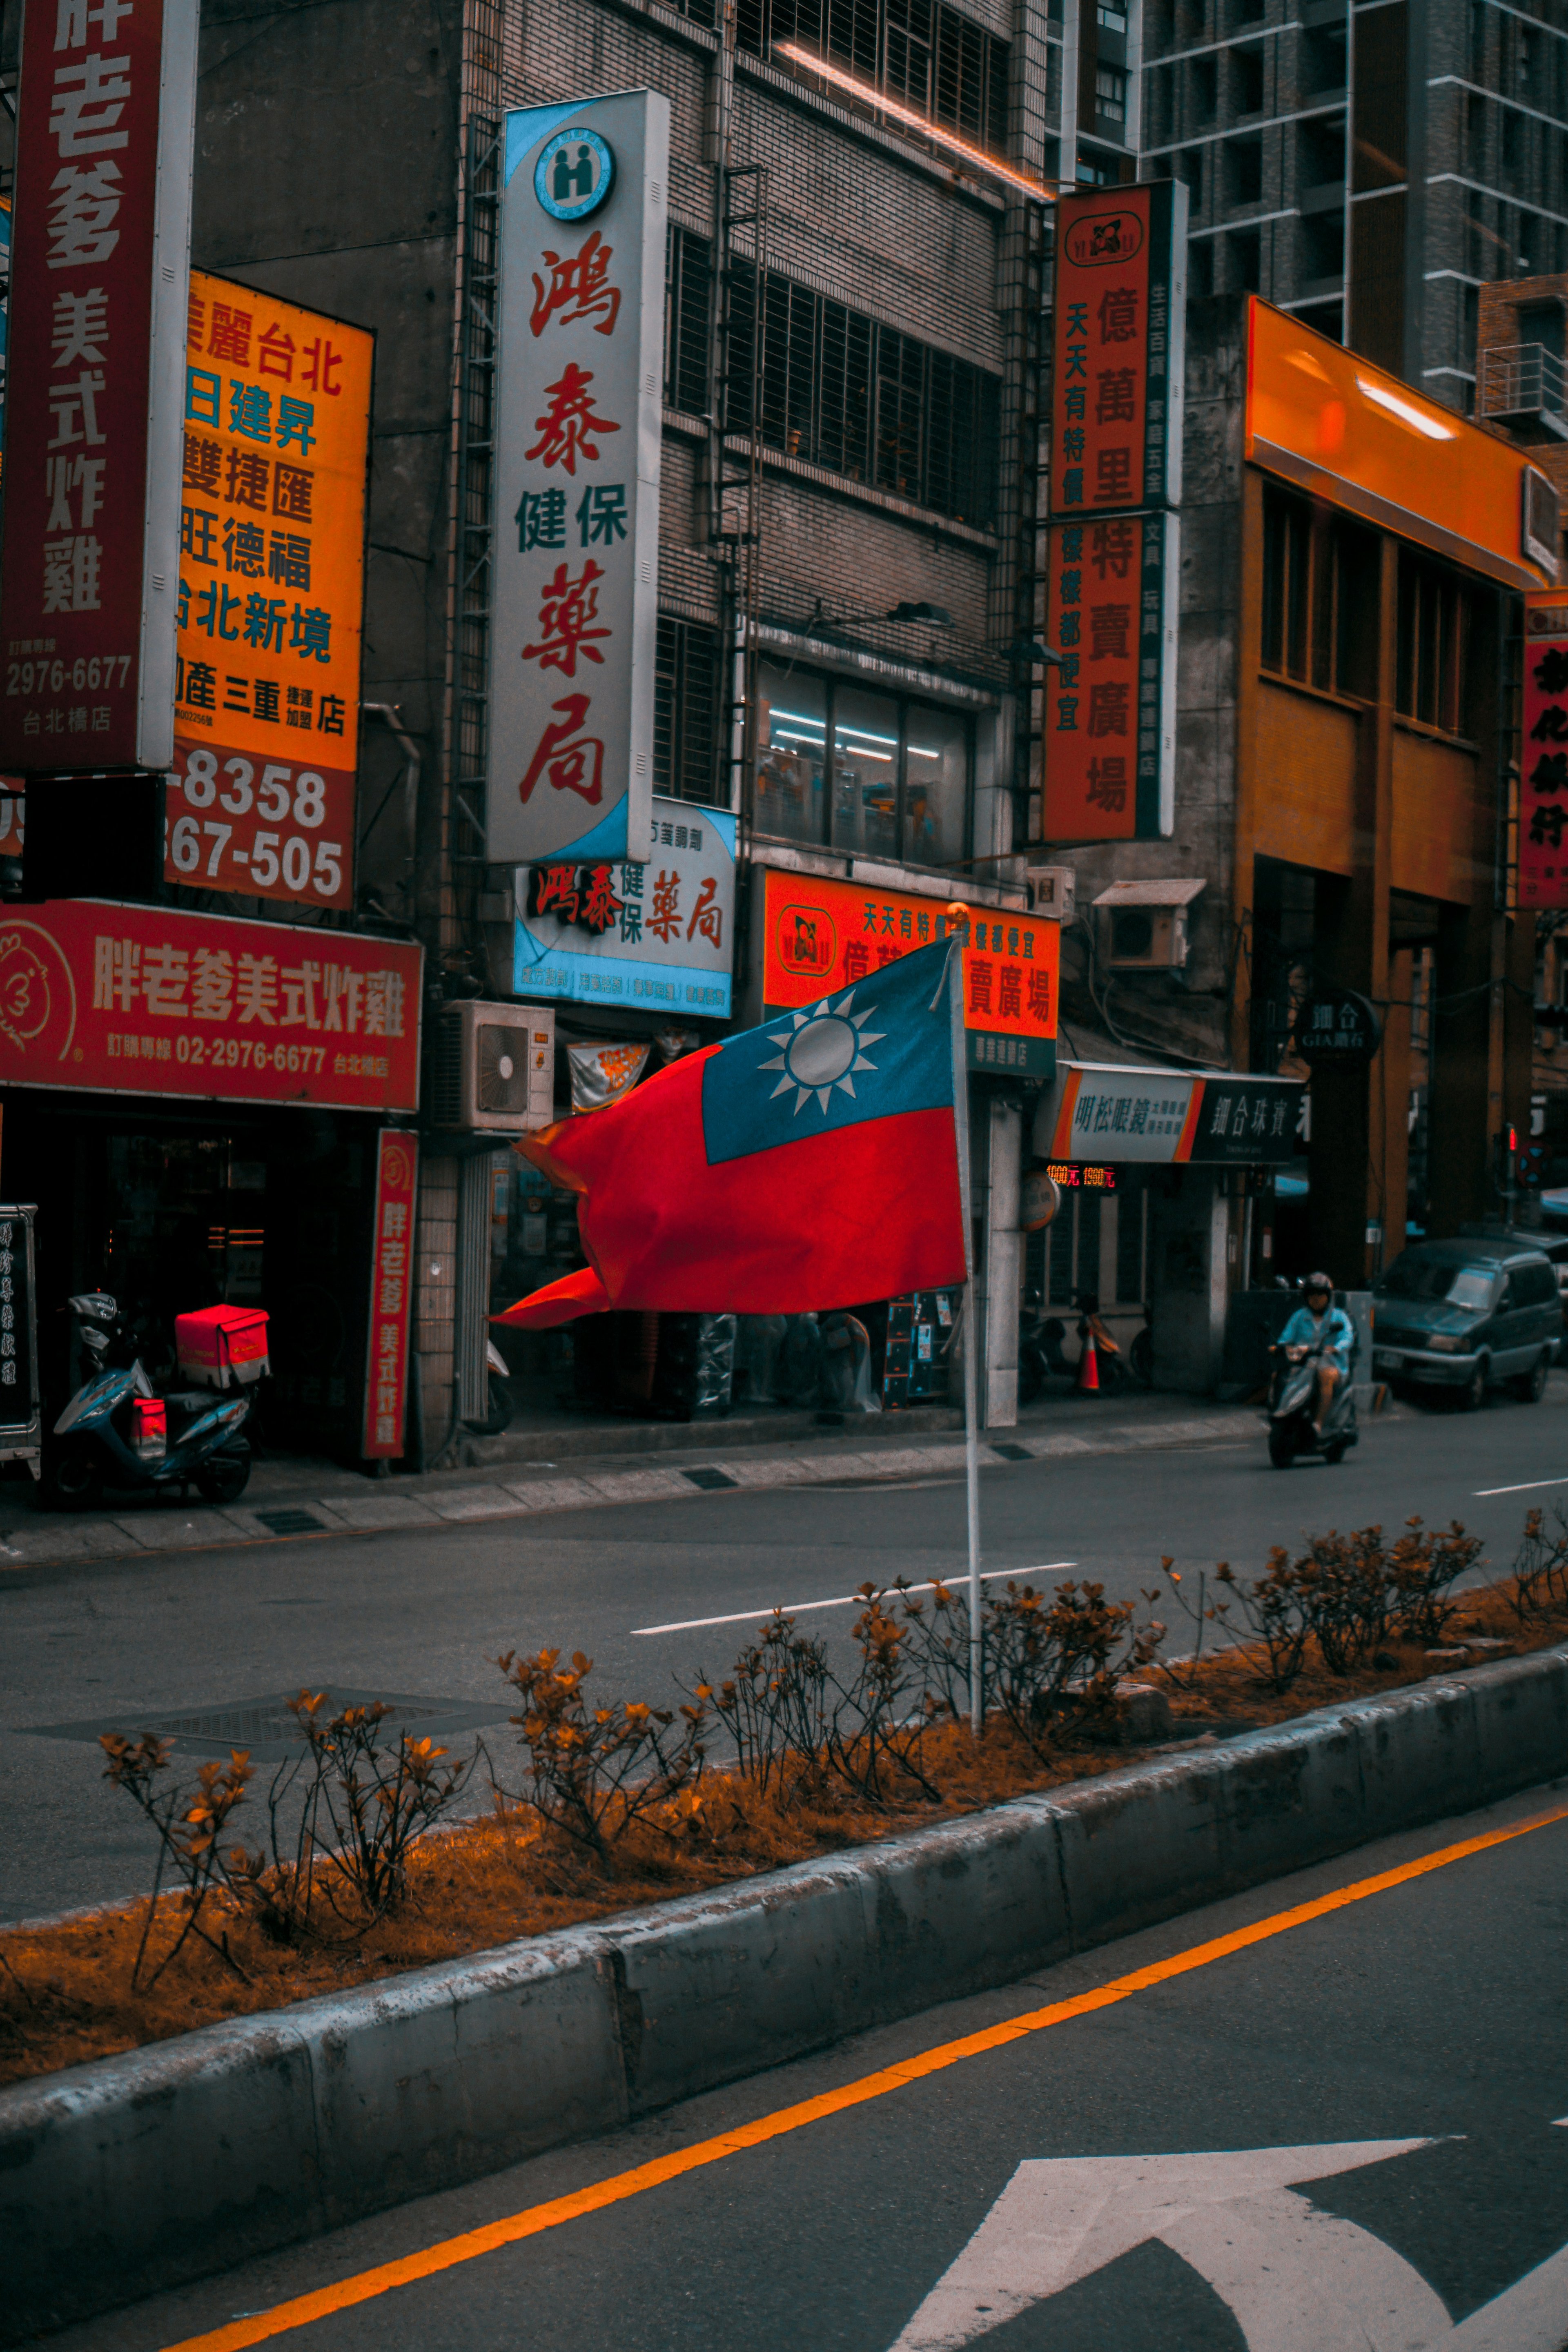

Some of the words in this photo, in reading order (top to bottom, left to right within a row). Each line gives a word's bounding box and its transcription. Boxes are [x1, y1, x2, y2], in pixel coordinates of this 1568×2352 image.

[1148, 282, 1167, 377] 生活百貨
[1063, 303, 1087, 505] 天天有特價
[1094, 287, 1138, 502] 億萬里
[42, 287, 109, 613] 美式炸雞
[183, 433, 315, 523] 雙捷匯
[180, 506, 312, 592] 旺德福
[514, 483, 628, 553] 健保
[1145, 521, 1160, 567] 文具
[1056, 527, 1083, 731] 樣樣都便宜
[1085, 522, 1133, 813] 特賣廣場
[6, 655, 131, 696] 2976-6677
[317, 694, 345, 737] 店
[519, 559, 612, 805] 藥局
[22, 705, 112, 735] 台北橋店
[164, 815, 343, 896] 67-505
[645, 870, 722, 949] 藥局
[863, 902, 946, 942] 天天有特價
[92, 935, 406, 1038] 胖老爹美式炸雞
[969, 959, 1051, 1023] 賣廣場
[176, 1034, 327, 1076] 02-2976-6677
[333, 1052, 390, 1078] 台北橋店
[1075, 1095, 1150, 1135] 明松眼鏡
[379, 1202, 407, 1314] 胖老爹
[375, 1323, 399, 1445] 美式炸雞
